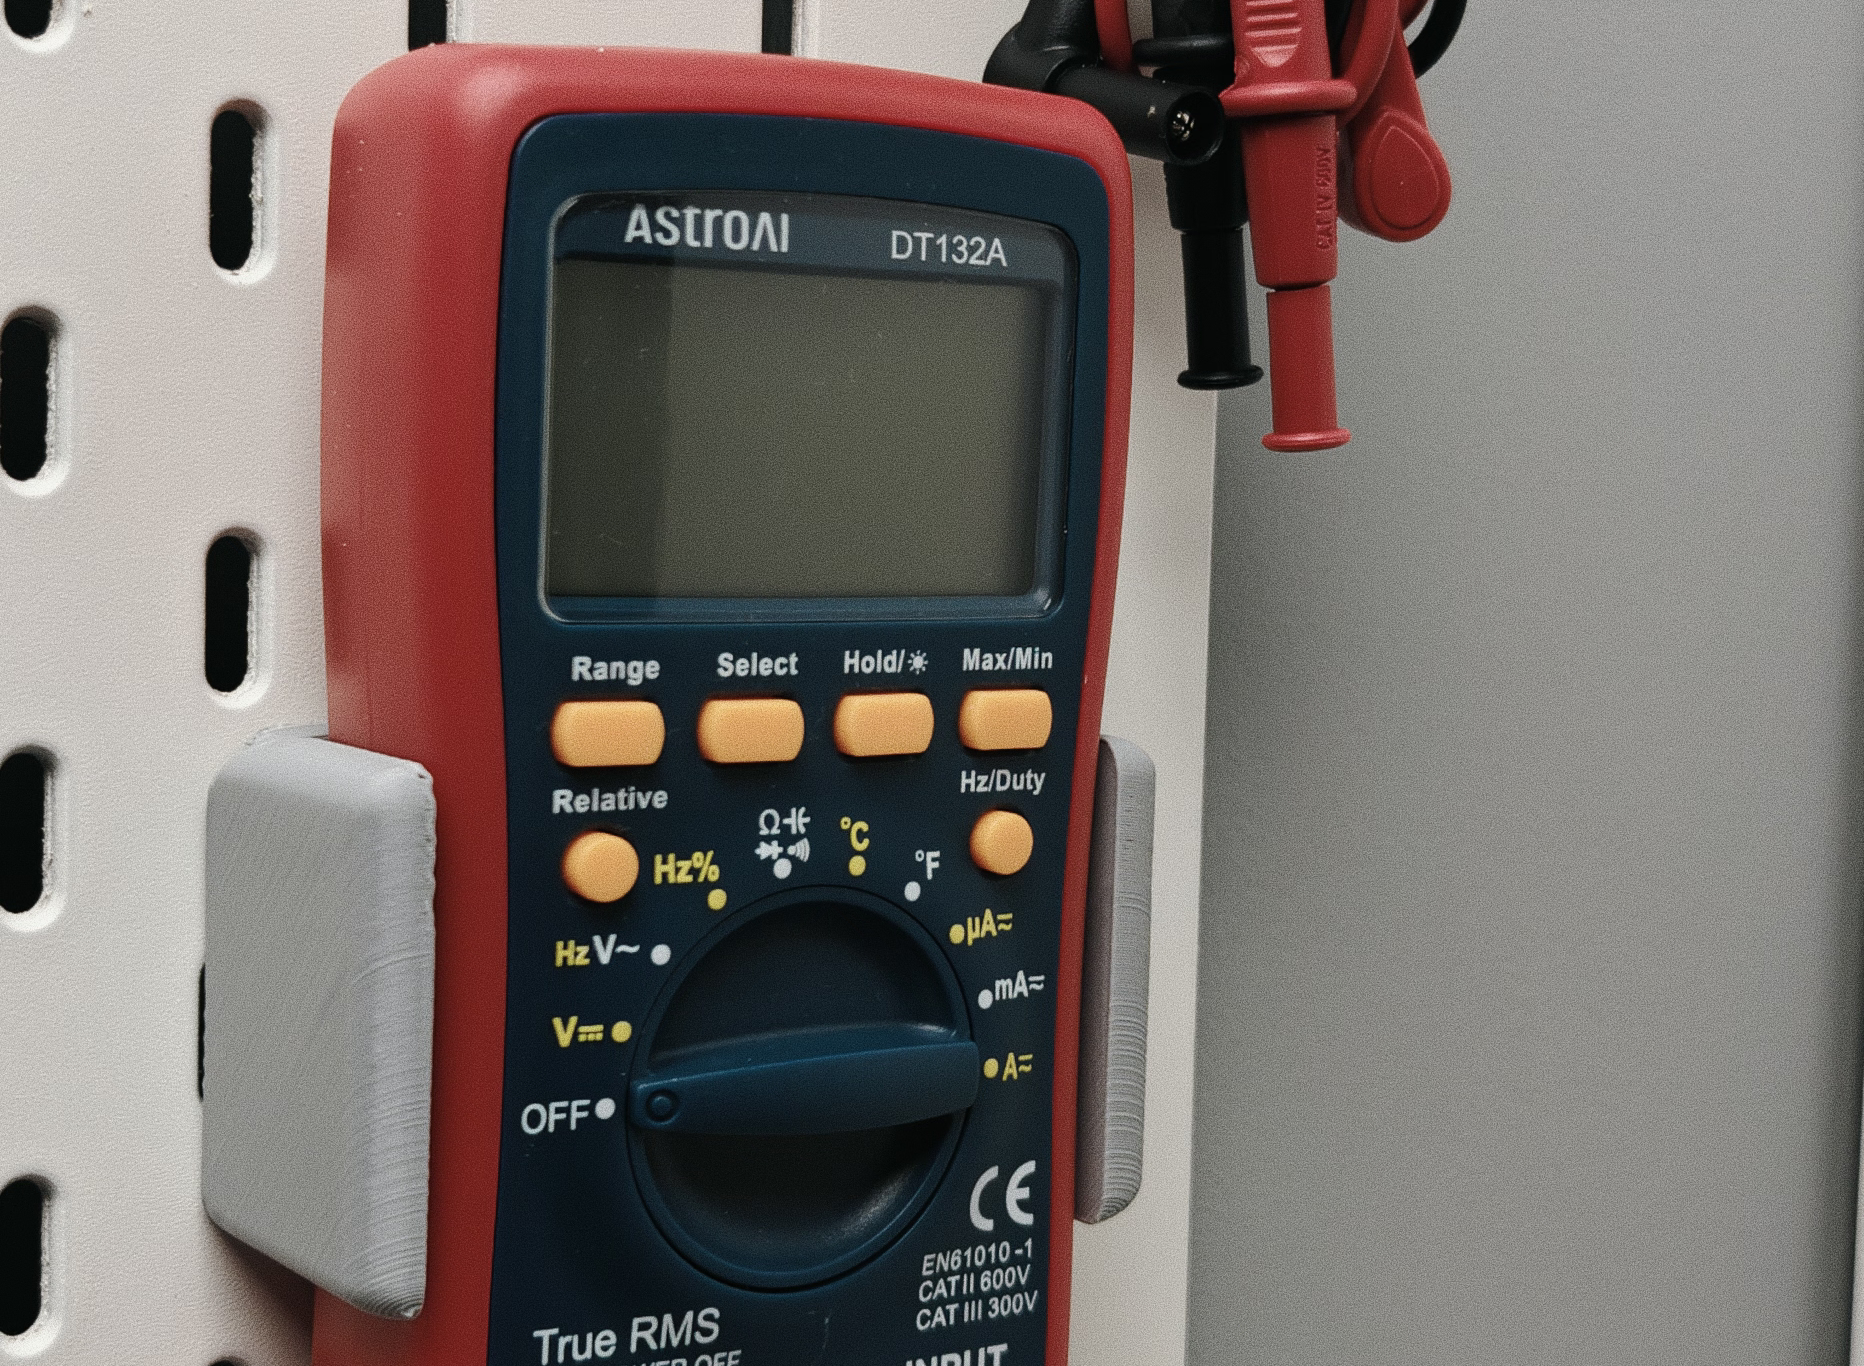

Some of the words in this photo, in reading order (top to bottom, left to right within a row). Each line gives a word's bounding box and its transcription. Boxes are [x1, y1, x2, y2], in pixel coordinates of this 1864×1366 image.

[891, 230, 1008, 267] DT132A
[571, 655, 661, 685] Range
[717, 652, 799, 678] Select
[962, 647, 1053, 671] Max/Min
[960, 769, 1046, 795] Hz/Duty
[552, 787, 669, 814] Relative
[653, 850, 720, 884] Hz%
[521, 1099, 591, 1135] OFF
[969, 1160, 1037, 1232] CE
[980, 1264, 1031, 1292] 600V
[915, 1303, 959, 1331] CAT
[963, 1299, 983, 1323] III
[988, 1290, 1038, 1319] 300V
[533, 1327, 617, 1366] True
[629, 1307, 720, 1354] RMS
